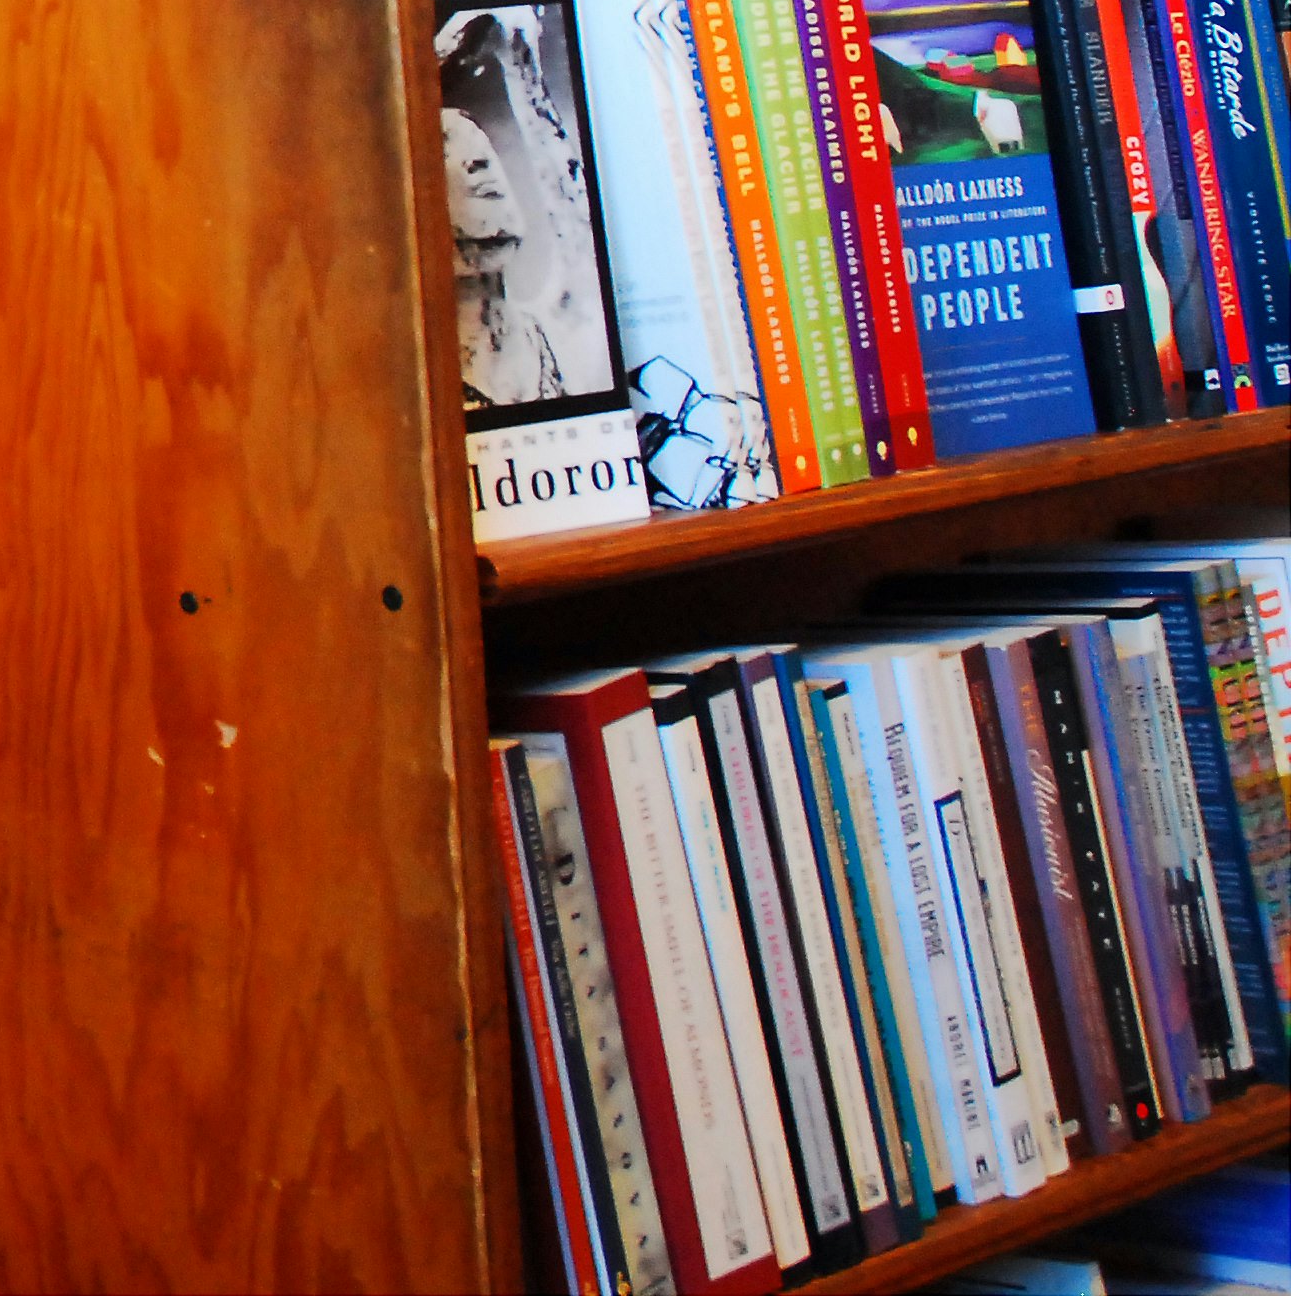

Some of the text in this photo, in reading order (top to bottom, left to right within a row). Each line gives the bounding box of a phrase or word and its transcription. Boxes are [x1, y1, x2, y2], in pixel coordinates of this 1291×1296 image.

[761, 59, 783, 104] THE
[784, 54, 807, 99] THE
[1170, 11, 1196, 97] Le Clézio
[1212, 23, 1257, 141] Bâtarde
[730, 134, 757, 199] BELL
[769, 112, 802, 215] GLACIER
[792, 108, 825, 211] GLACIER
[813, 67, 847, 186] RECLAIMED
[839, 209, 859, 274] HALLDÓR
[851, 281, 872, 351] LAXNESS
[847, 73, 880, 164] LIGHT
[872, 203, 893, 265] HALLDÓR
[884, 268, 903, 335] LAXNESS
[959, 175, 1024, 203] LAXNESS
[1125, 134, 1150, 206] crazy
[1192, 127, 1236, 319] WANDERING STAR
[1244, 190, 1278, 325] VIOLETTE LEDUC
[749, 218, 792, 387] HALLDÓR LAXNESS
[921, 283, 1025, 332] PEOPLE
[809, 328, 836, 413] LAXNESS
[832, 324, 857, 408] LAXNESS
[883, 718, 945, 957] REQUIEM FOR LOST EMPIRE
[1025, 748, 1073, 903] Illusionist
[1052, 688, 1114, 951] MAN'S FATE
